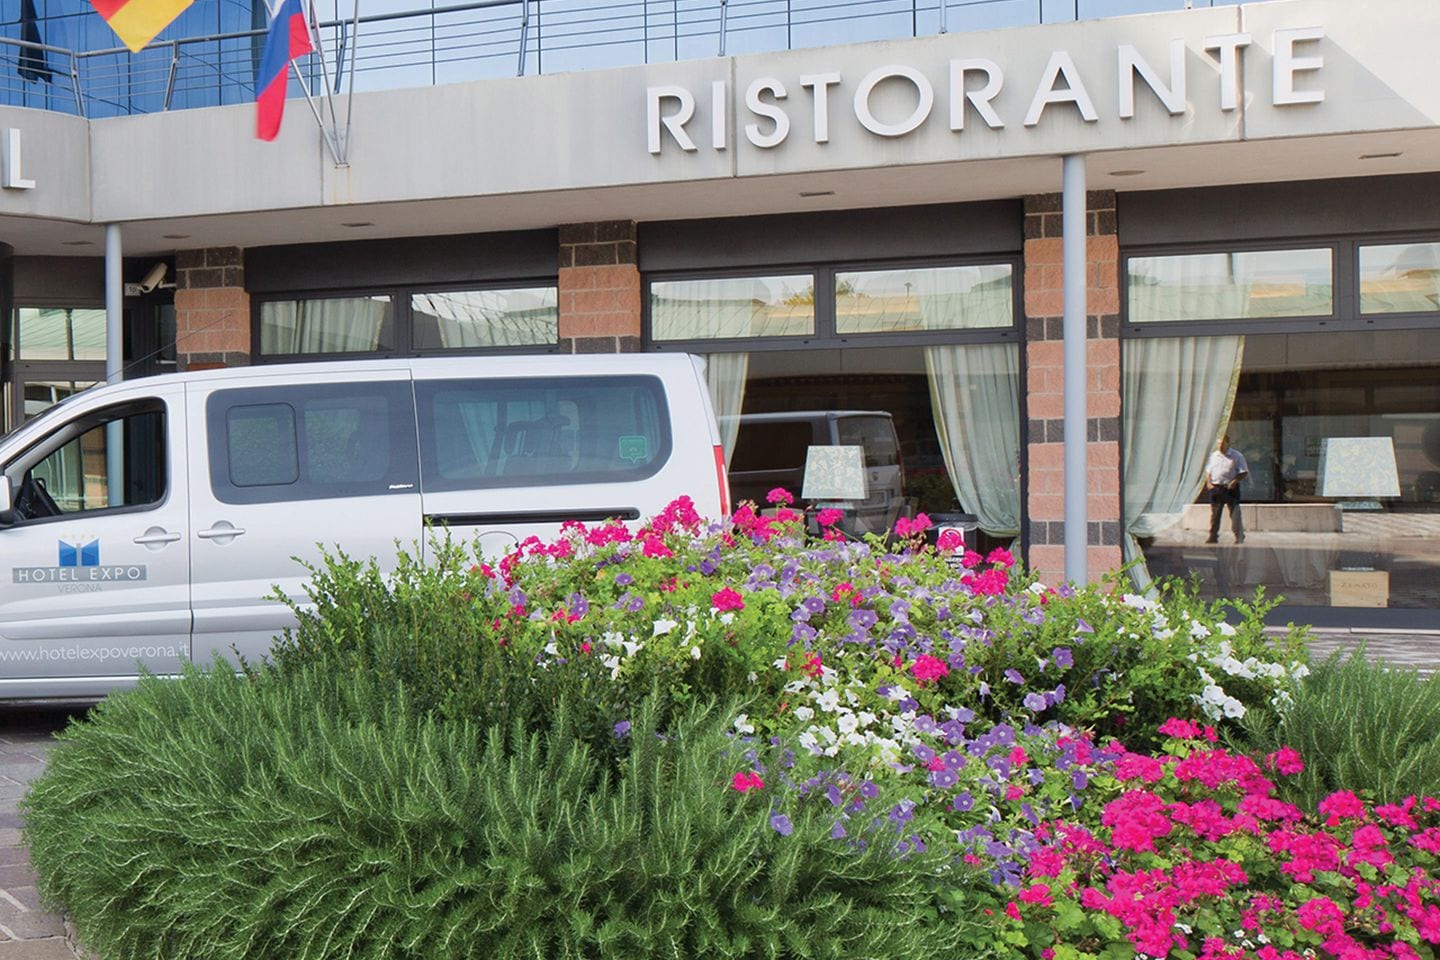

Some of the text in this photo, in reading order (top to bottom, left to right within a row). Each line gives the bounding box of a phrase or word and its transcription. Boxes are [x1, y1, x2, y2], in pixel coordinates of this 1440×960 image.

[647, 27, 1325, 154] RISTORANTE
[19, 566, 141, 582] HOTEL EXPO
[56, 583, 104, 593] VERONA
